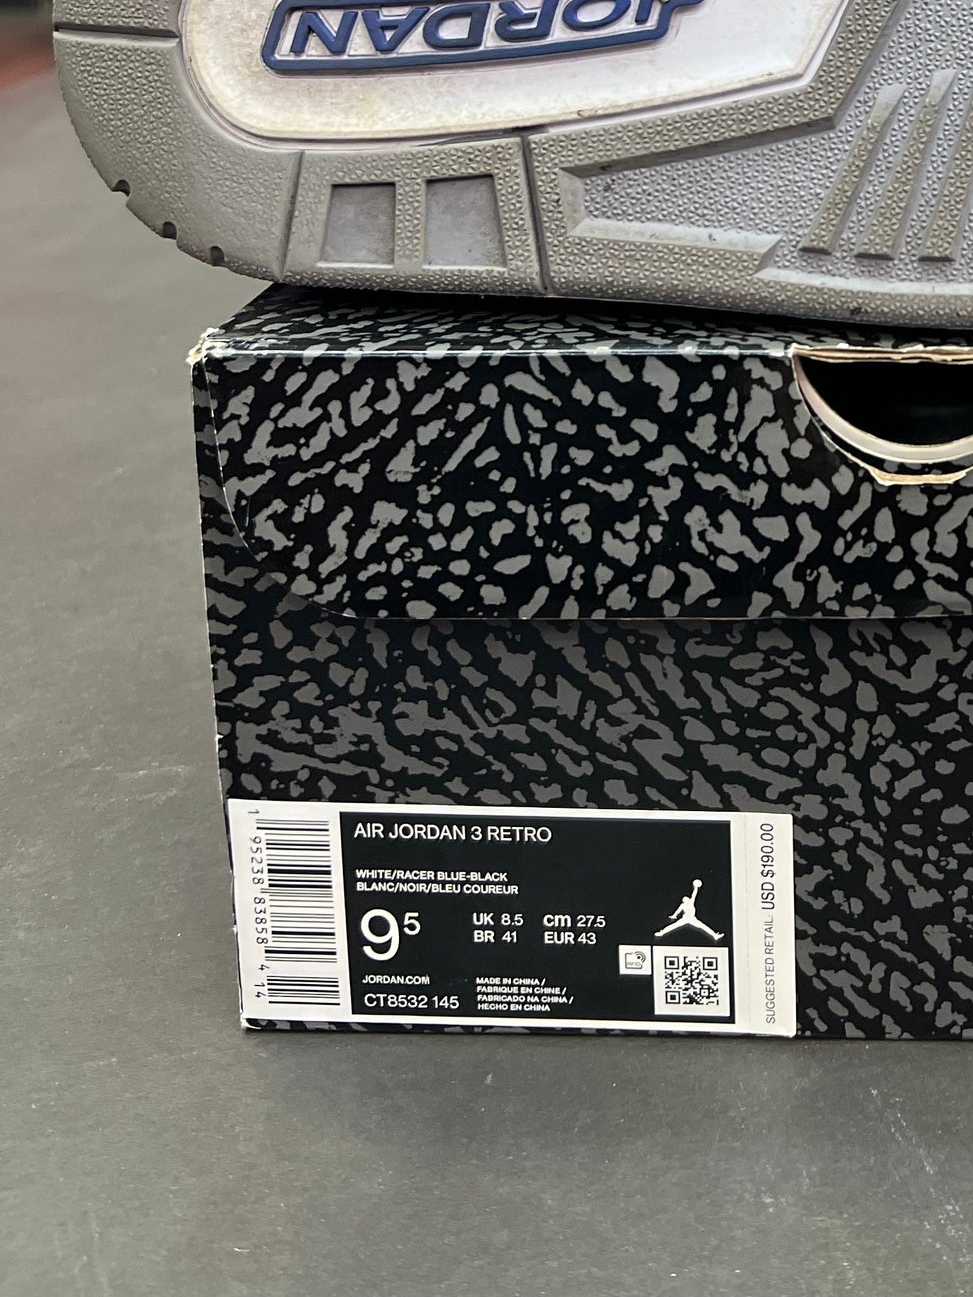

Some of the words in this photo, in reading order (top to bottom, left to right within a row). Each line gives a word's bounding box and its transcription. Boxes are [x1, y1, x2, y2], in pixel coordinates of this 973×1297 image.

[354, 823, 384, 838] AIR
[388, 823, 466, 840] JORDAN
[470, 826, 483, 841] 3
[487, 826, 552, 842] RETRO
[760, 823, 776, 878] $190.00
[250, 836, 264, 885] 95238
[356, 869, 435, 880] WHITE/RACER
[437, 871, 508, 882] BLUE-BLACK
[356, 882, 461, 893] BLANC/NOIR/BLEU
[463, 883, 519, 894] COUREUR
[761, 881, 775, 910] USD
[253, 896, 269, 945] 83858
[473, 913, 494, 926] UK
[501, 913, 524, 926] 8.5
[543, 914, 572, 927] cm
[576, 915, 606, 928] 27.5
[473, 930, 495, 943] BR
[501, 930, 517, 943] 41
[544, 931, 575, 944] EUR
[577, 932, 597, 945] 43
[362, 974, 430, 985] JORDAN.COM
[502, 977, 512, 985] IN
[476, 985, 519, 993] FABRIQUE
[765, 957, 776, 1024] SUGGESTED
[364, 993, 429, 1009] CT8532
[431, 995, 460, 1009] 145
[477, 994, 526, 1002] FABRICADO
[477, 1003, 509, 1011] HECHO
[509, 1003, 522, 1011] EN
